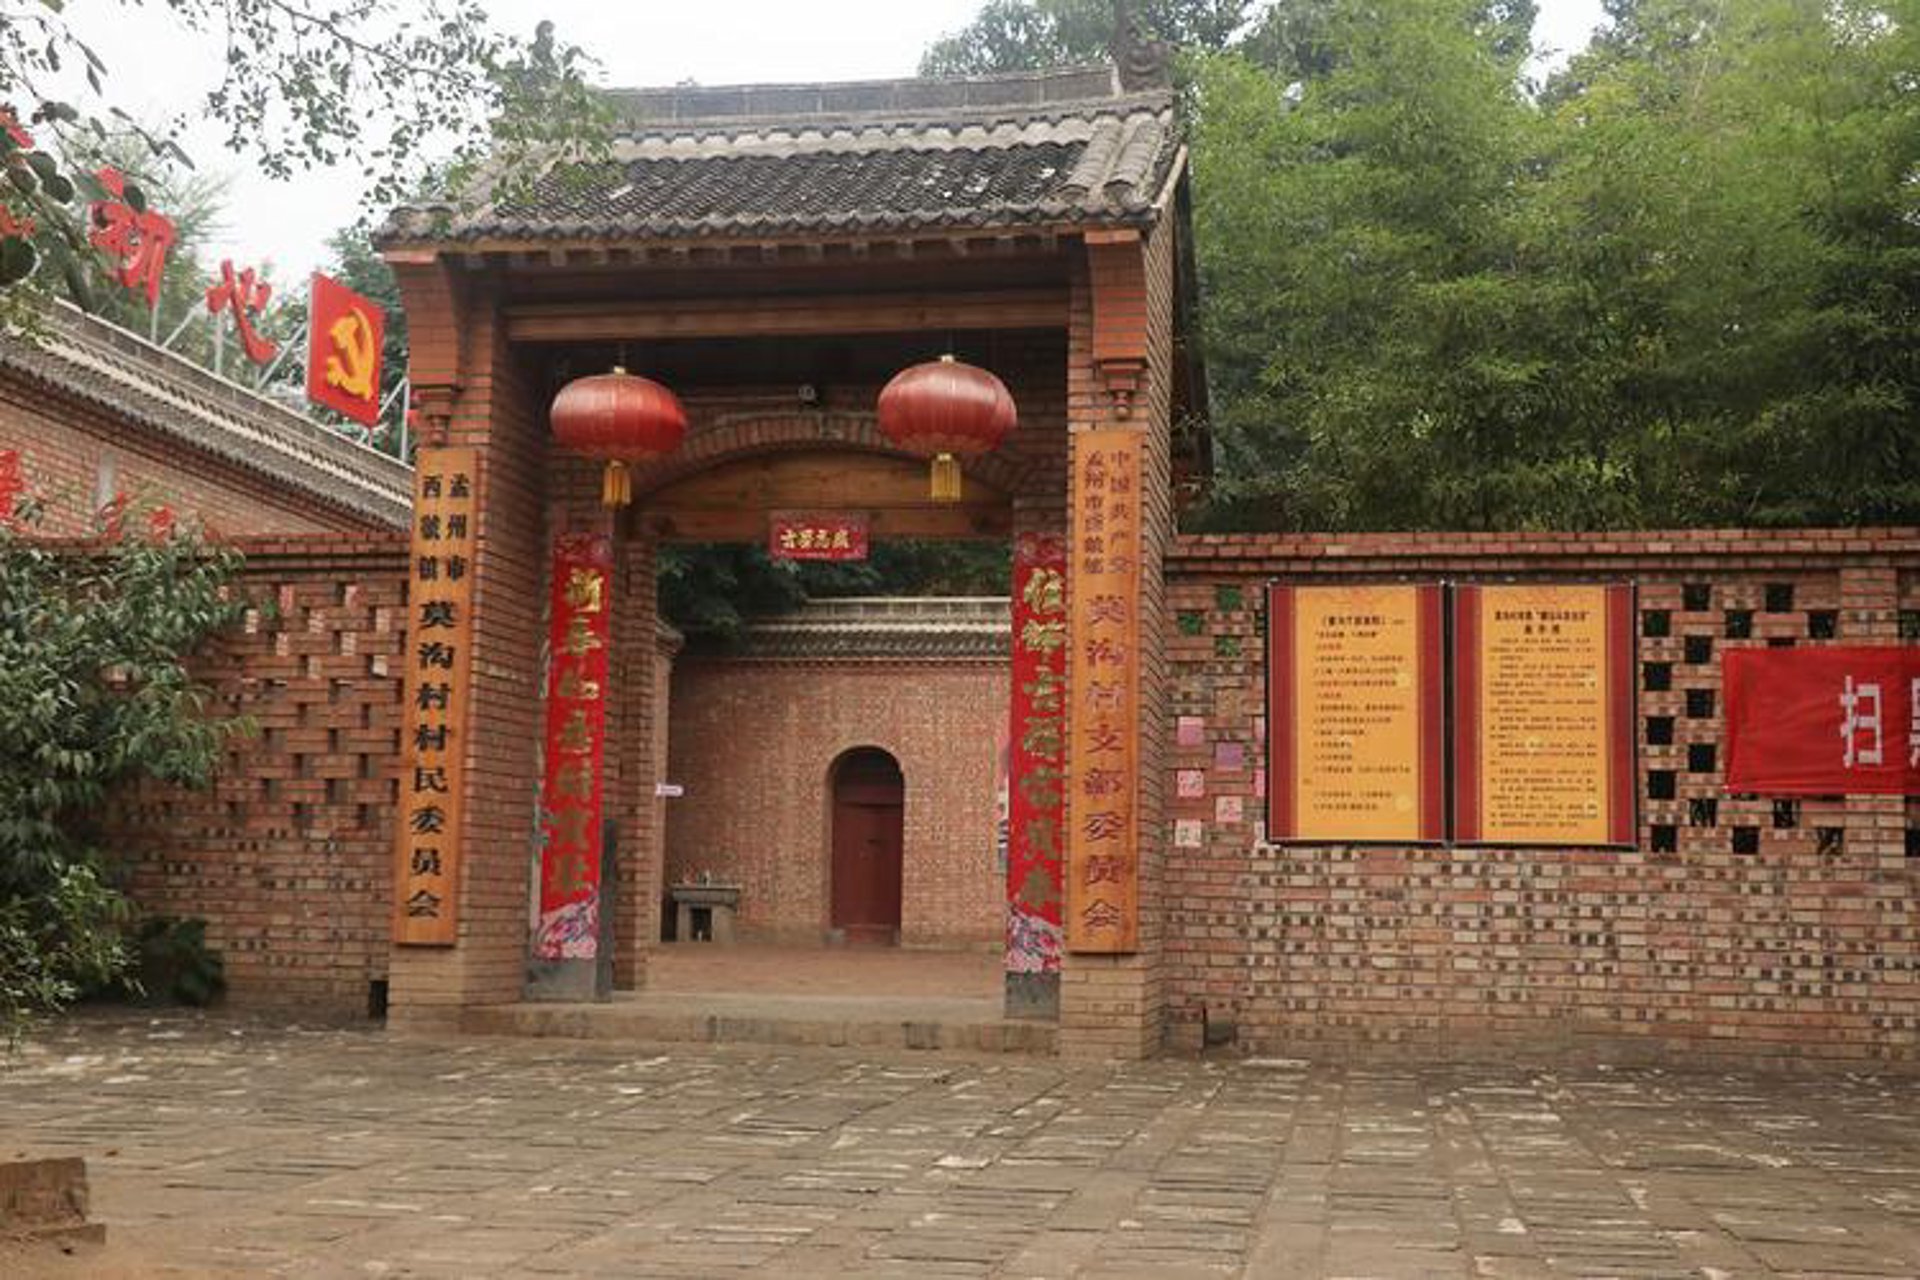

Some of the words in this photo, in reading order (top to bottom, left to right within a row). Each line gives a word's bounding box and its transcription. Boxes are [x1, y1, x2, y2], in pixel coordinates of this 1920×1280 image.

[446, 473, 470, 582] 孟州市
[407, 601, 457, 918] 莫沟村村民委员会
